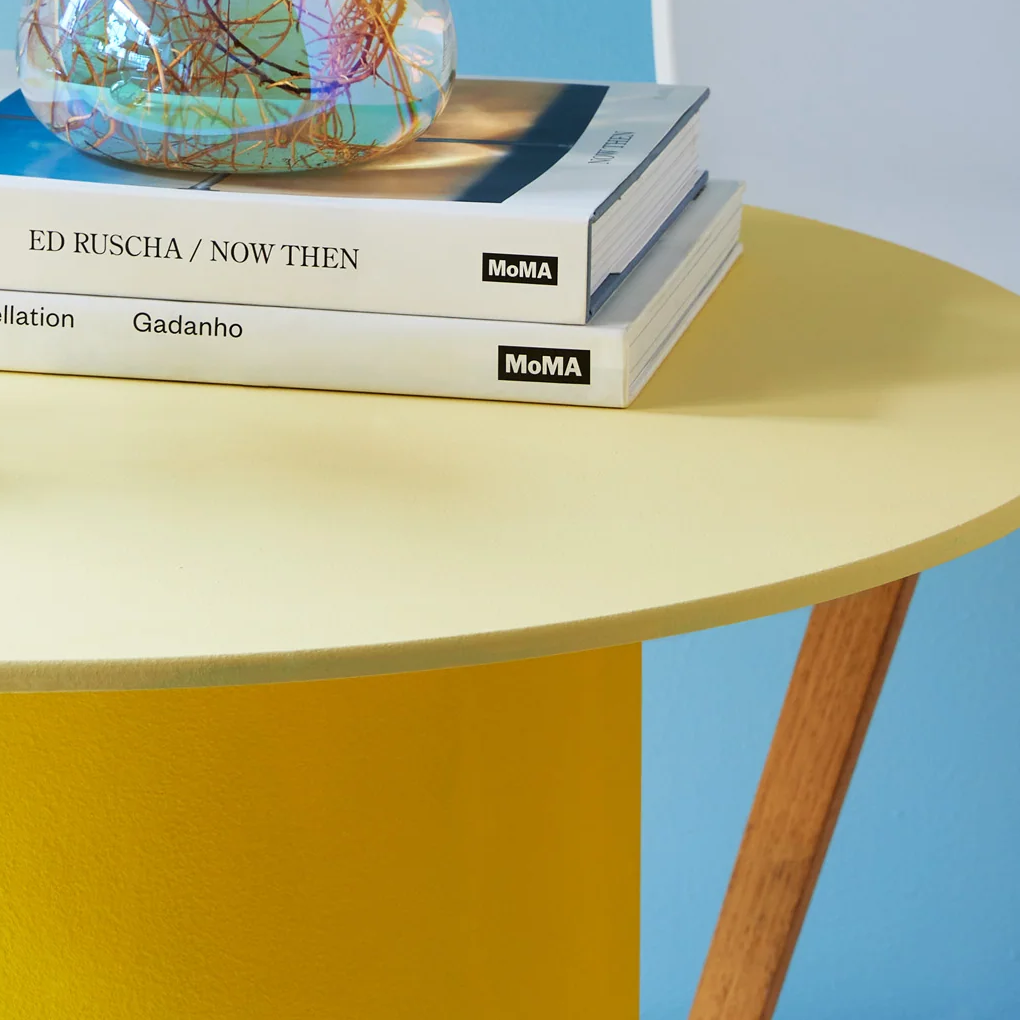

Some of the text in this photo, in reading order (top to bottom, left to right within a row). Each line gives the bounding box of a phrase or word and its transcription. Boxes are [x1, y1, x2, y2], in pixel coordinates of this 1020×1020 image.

[587, 130, 636, 164] NOW THEN
[28, 229, 360, 270] ED RUSCHA / NOW THEN
[488, 258, 553, 280] MoMA
[132, 311, 243, 339] Gadanho
[505, 353, 583, 377] MoMA
